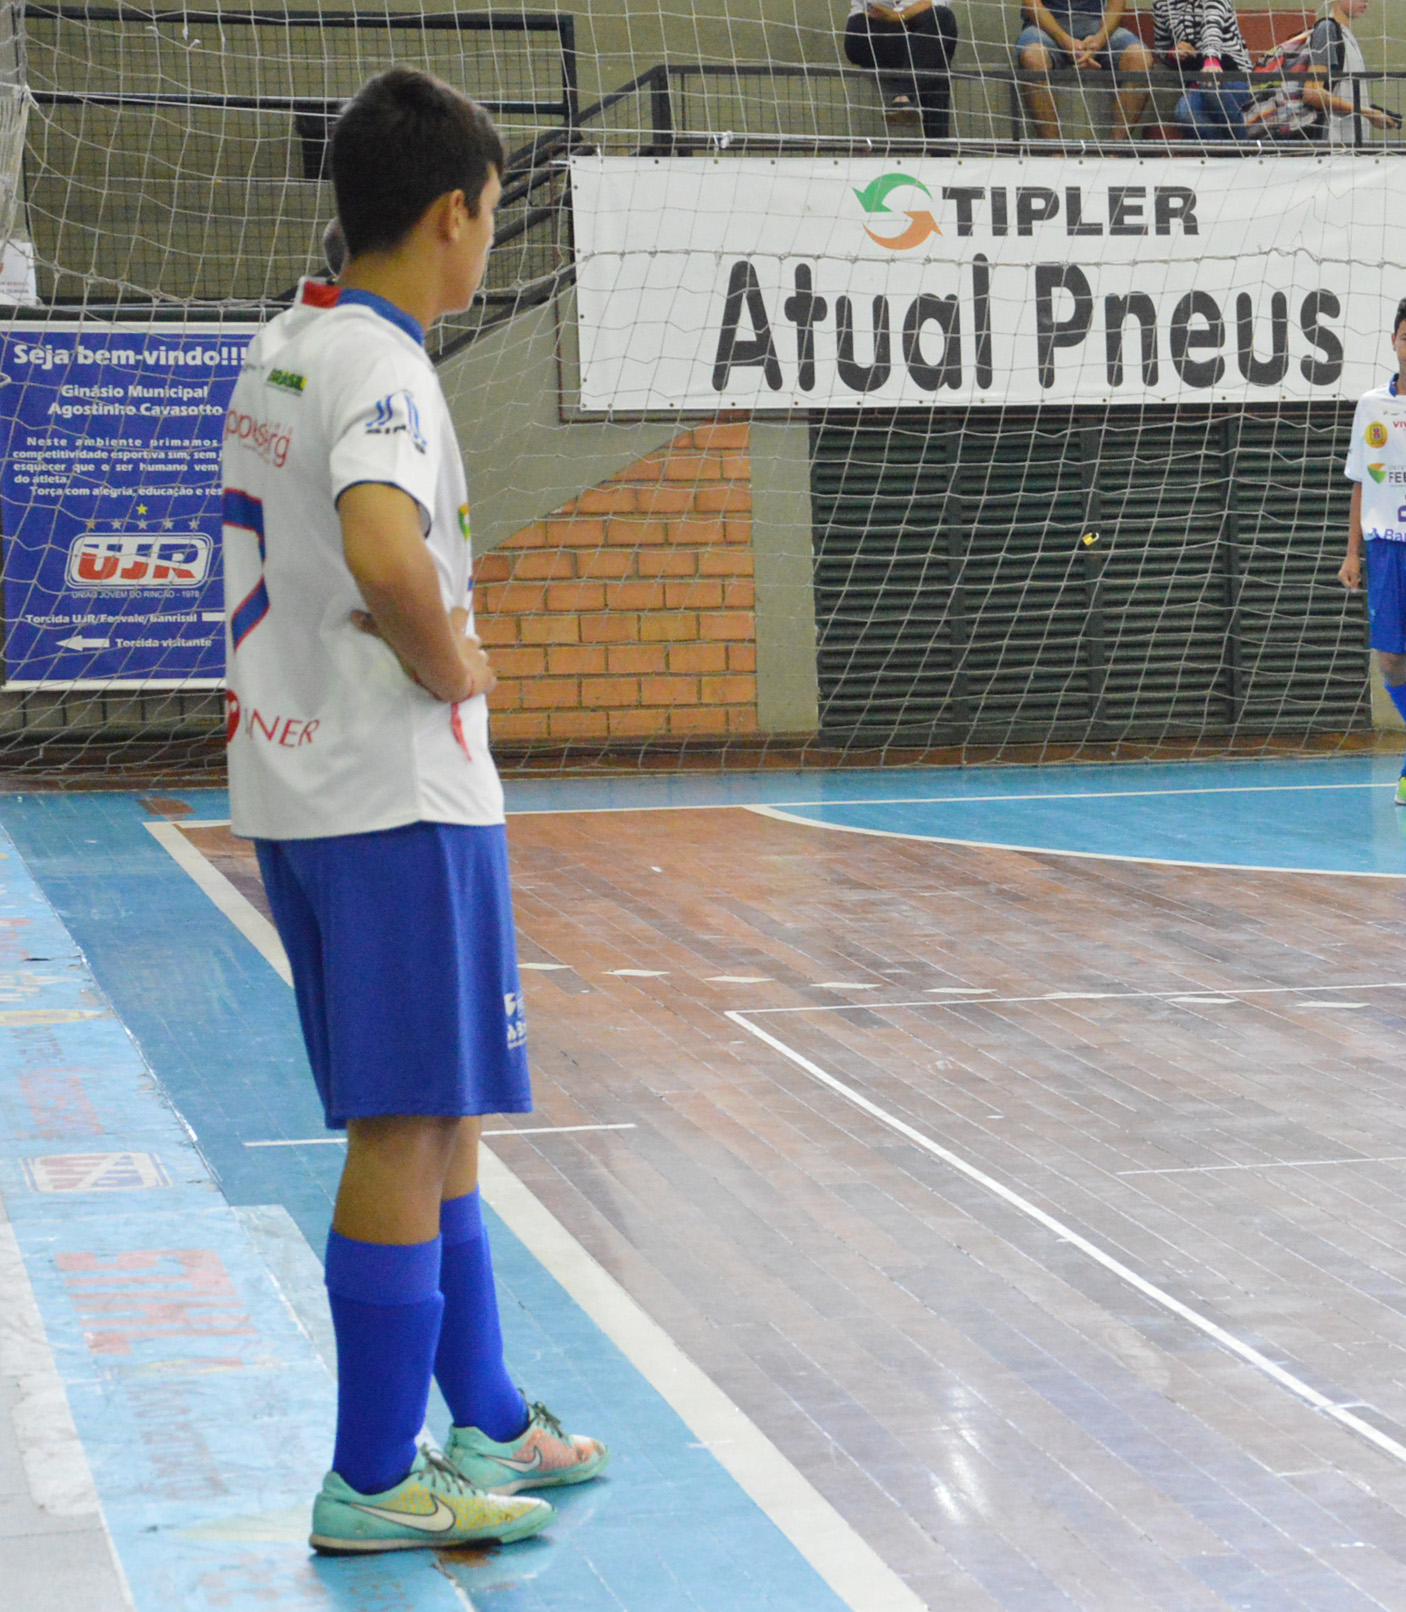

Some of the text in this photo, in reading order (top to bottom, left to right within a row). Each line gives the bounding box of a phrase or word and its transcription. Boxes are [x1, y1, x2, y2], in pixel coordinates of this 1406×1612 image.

[942, 186, 1199, 236] TIPLER
[711, 253, 1344, 392] Atual Pneus
[14, 344, 247, 369] Seja bem-vindo!!!
[61, 384, 208, 401] Ginásio Municipal
[48, 403, 223, 418] Agostinho Cavasotto
[27, 437, 218, 449] Neste ambiente primamos
[13, 450, 108, 461] competitividade
[110, 450, 165, 461] esportiva
[193, 452, 216, 460] sem
[13, 462, 218, 473] esquecer que o ser humano vem
[14, 474, 30, 484] do
[64, 488, 90, 496] com
[92, 486, 136, 498] alegria,
[196, 488, 203, 496] e
[78, 543, 199, 580] UJR
[25, 613, 70, 624] Torcida
[115, 637, 159, 648] Torcida
